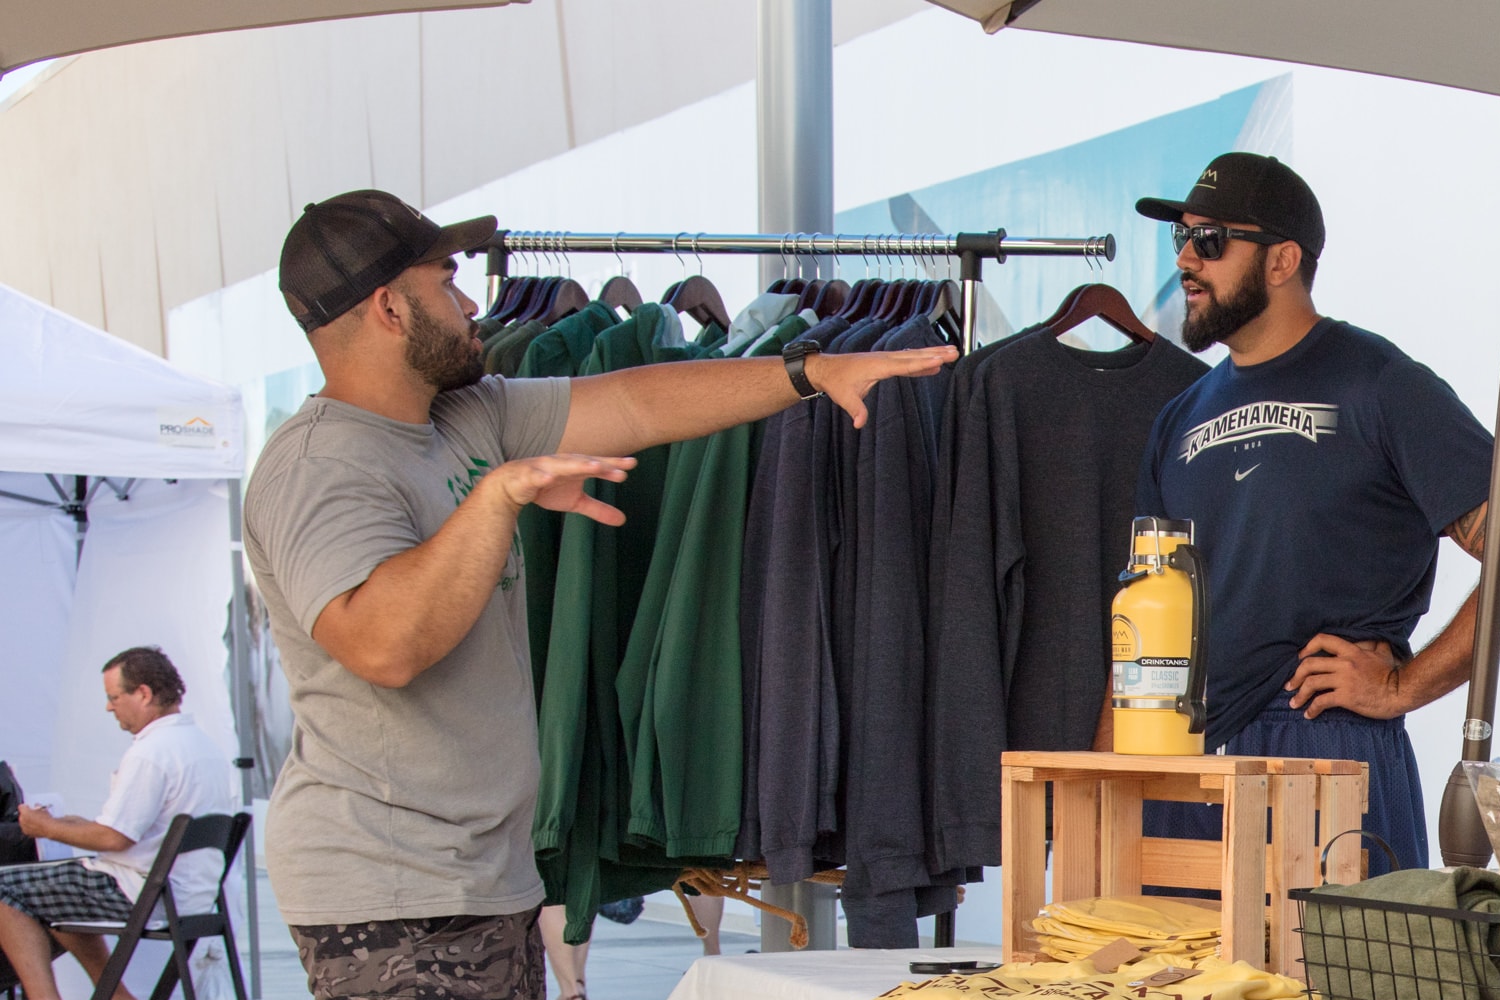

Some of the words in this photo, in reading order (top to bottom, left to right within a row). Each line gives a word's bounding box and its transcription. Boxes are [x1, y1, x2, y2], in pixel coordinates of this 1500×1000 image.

[1187, 402, 1315, 460] KAMEHAMEHA
[1244, 440, 1262, 451] MUA
[1151, 670, 1179, 681] CLASSIC
